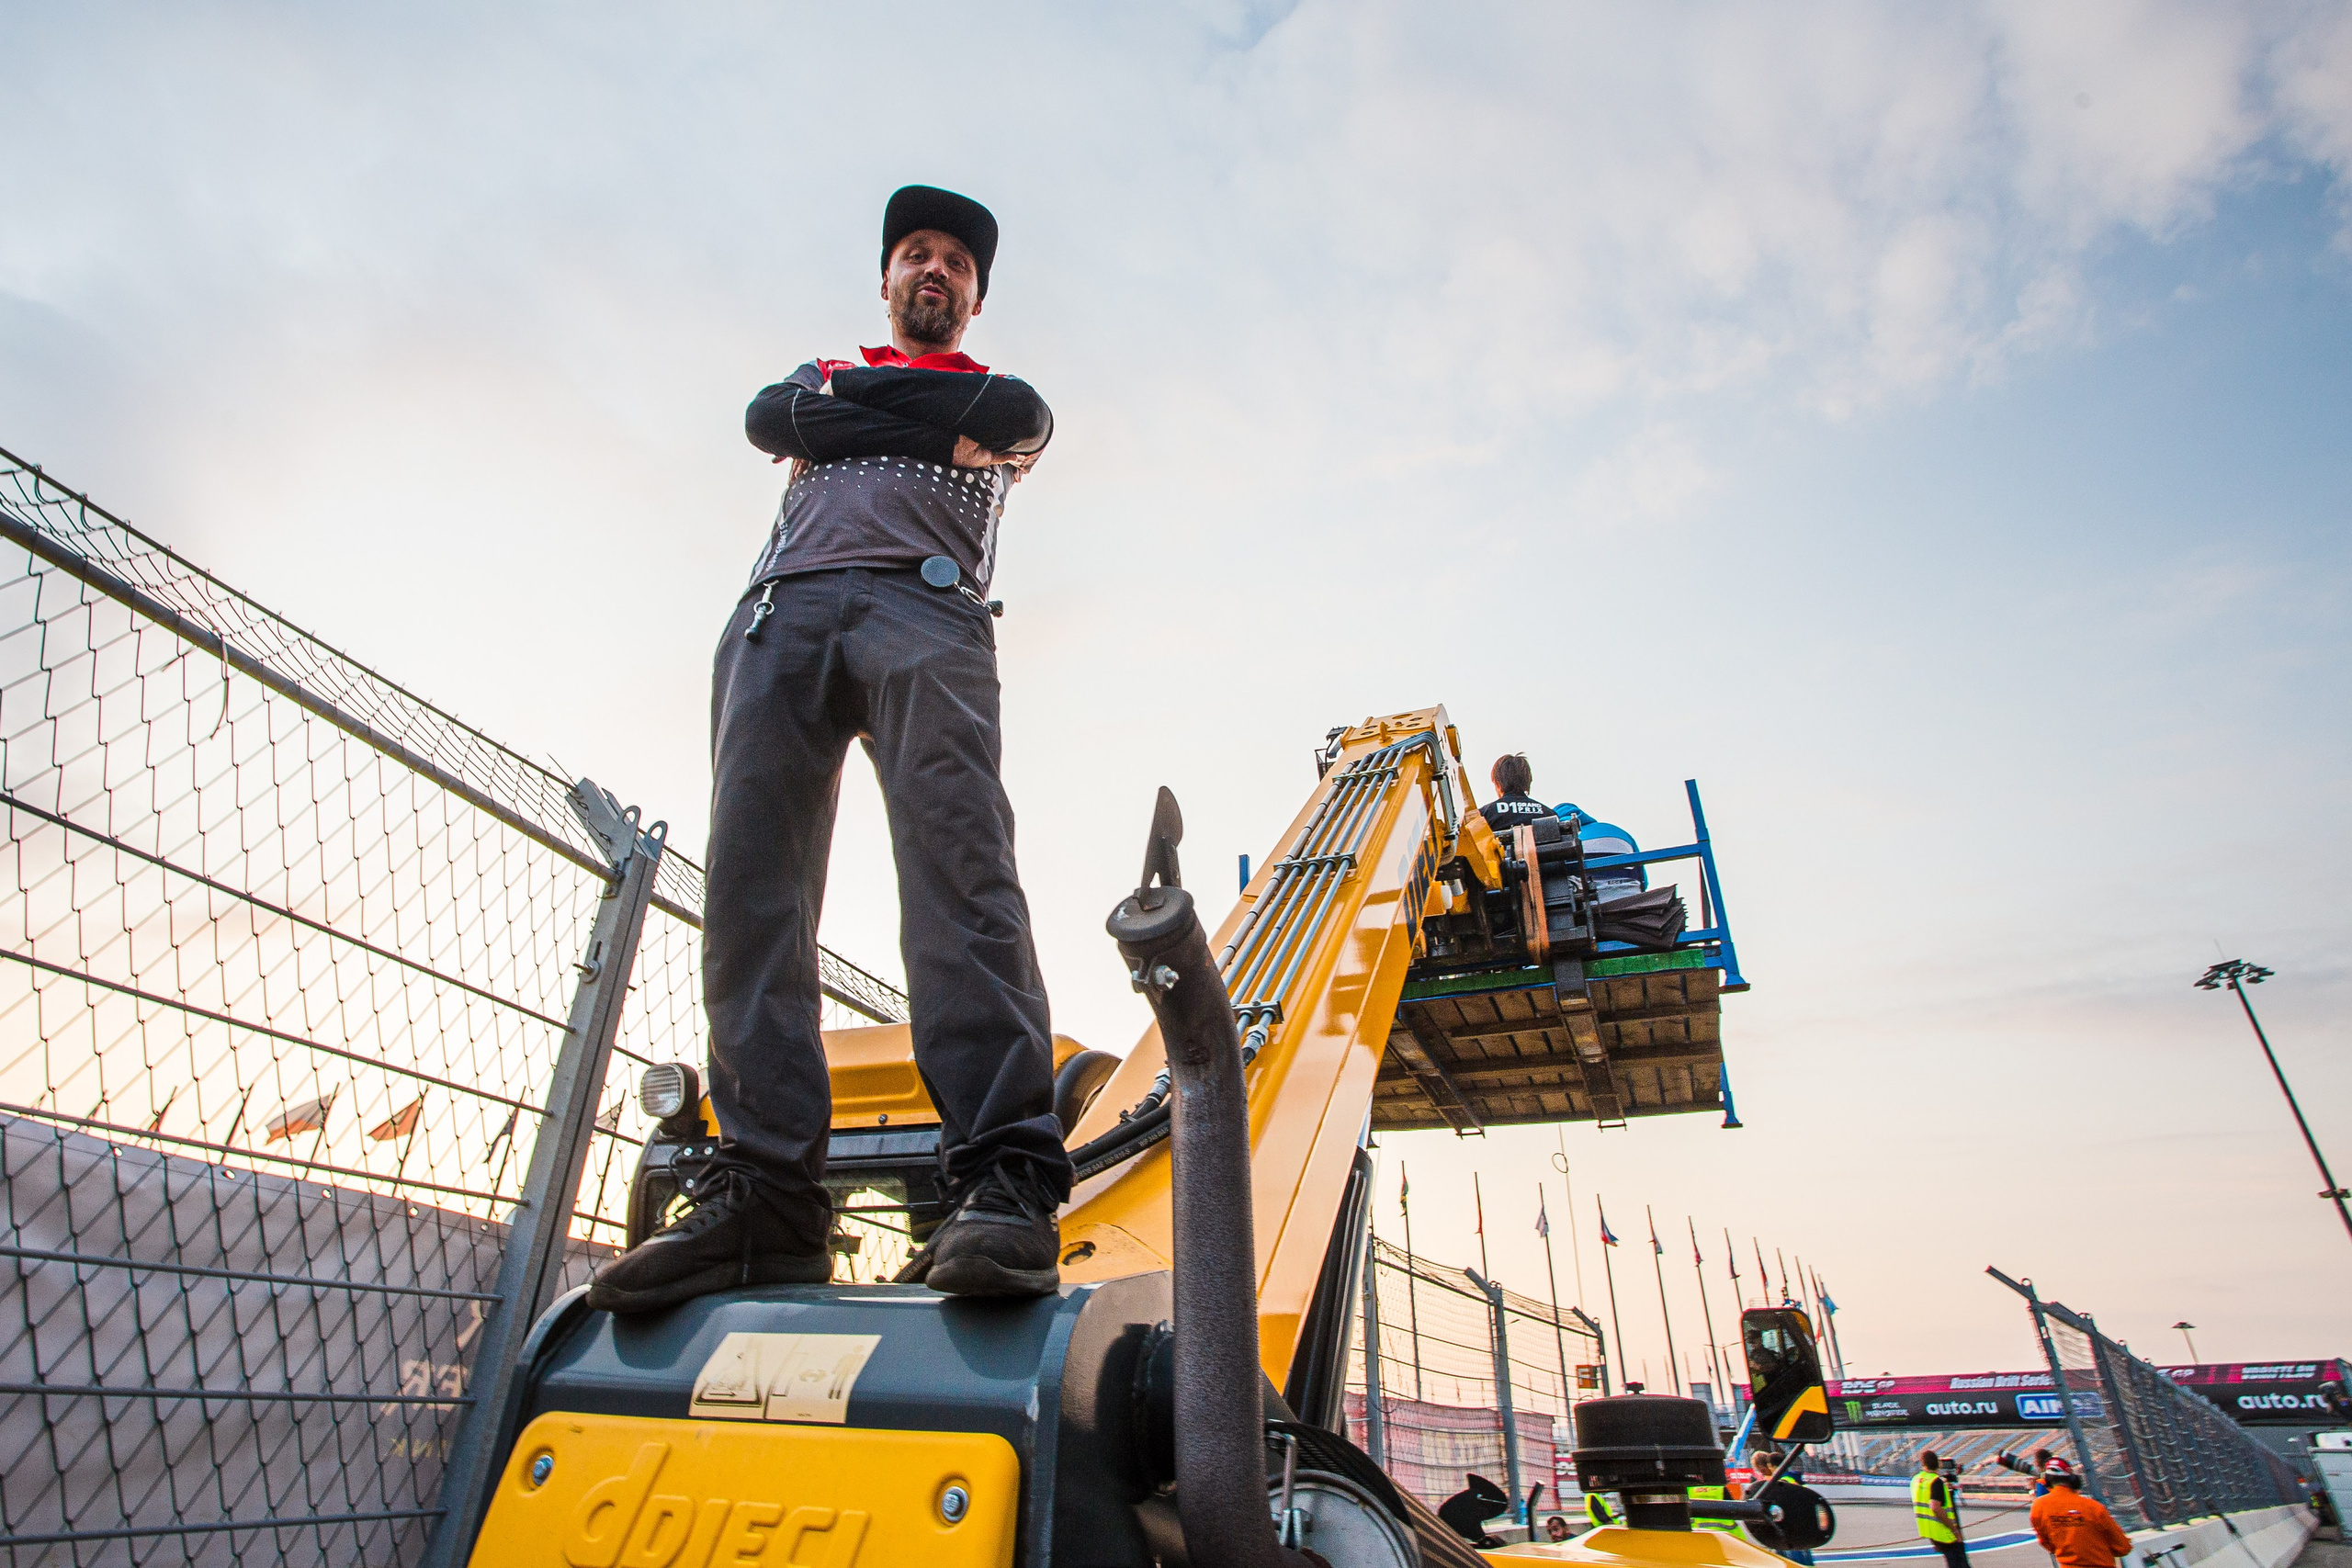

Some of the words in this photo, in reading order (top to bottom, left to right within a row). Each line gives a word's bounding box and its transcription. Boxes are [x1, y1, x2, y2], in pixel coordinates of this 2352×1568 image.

[1496, 802, 1518, 813] D1
[1950, 1377, 1995, 1389] Russian
[1994, 1374, 2020, 1387] Drift
[1926, 1401, 1999, 1416] auto.ru
